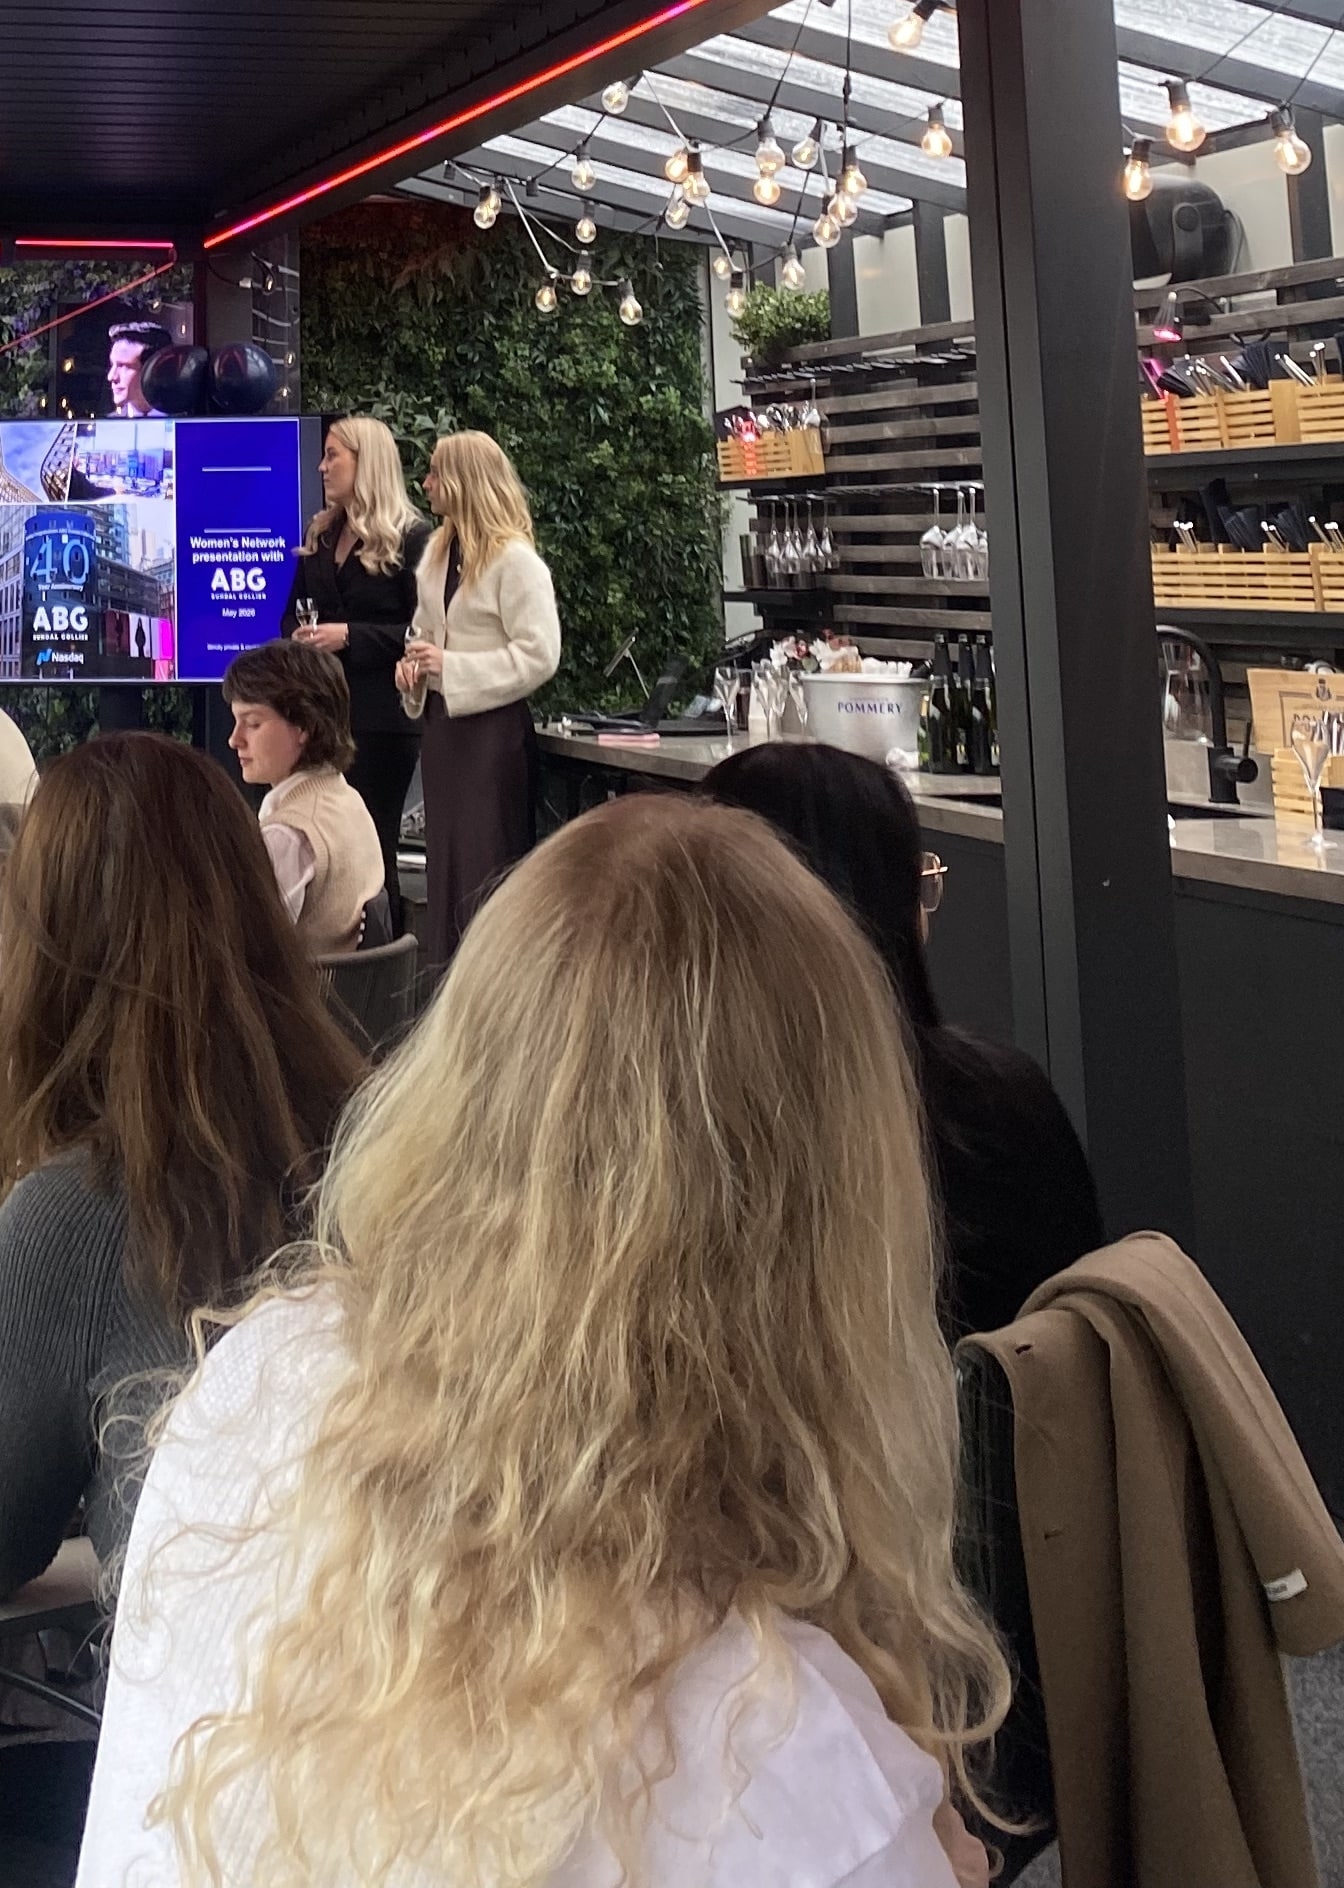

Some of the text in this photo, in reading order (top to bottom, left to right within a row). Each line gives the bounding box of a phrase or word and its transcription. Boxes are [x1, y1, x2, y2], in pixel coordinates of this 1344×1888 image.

[189, 536, 286, 549] Women's Network
[30, 535, 90, 585] 40
[192, 550, 284, 565] presentation with
[211, 567, 266, 592] ABG
[33, 606, 88, 632] ABG
[222, 608, 237, 618] May
[51, 651, 84, 665] Nasdaq
[837, 702, 902, 714] POMMERY
